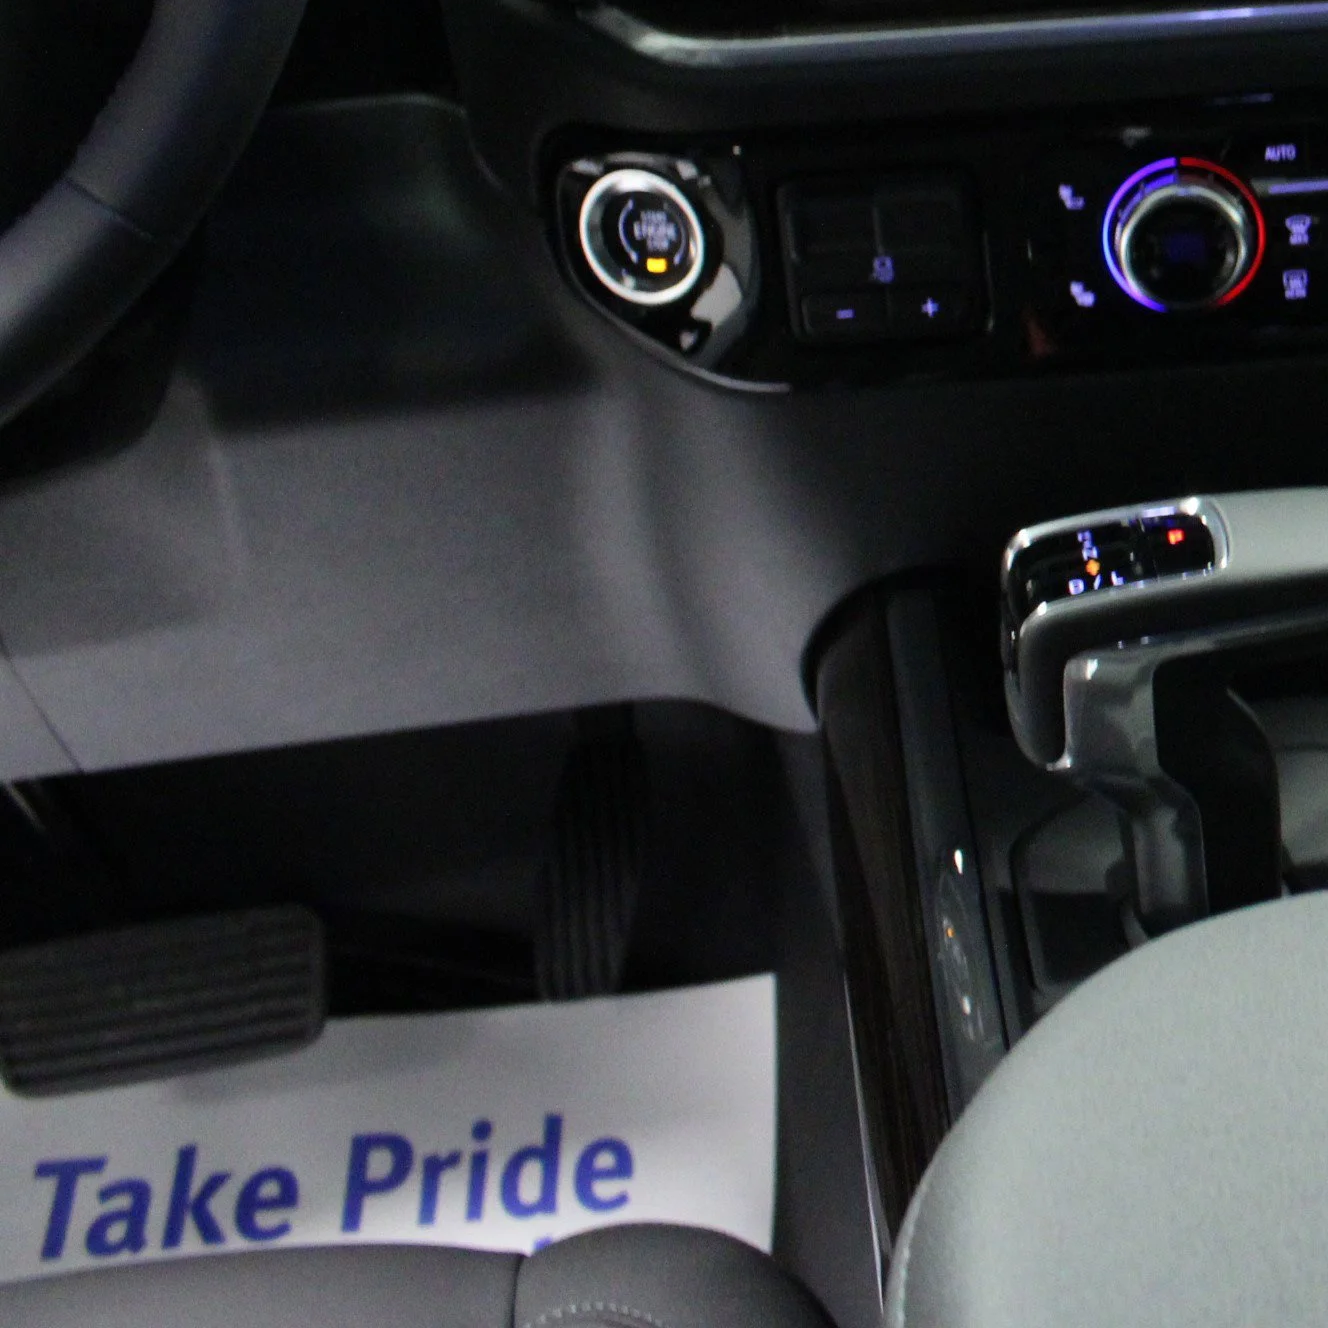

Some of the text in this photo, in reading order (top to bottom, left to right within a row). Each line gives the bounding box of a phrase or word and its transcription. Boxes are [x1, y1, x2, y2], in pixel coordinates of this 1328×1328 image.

[1264, 143, 1297, 161] AUTO
[34, 1113, 634, 1262] Take Pride
